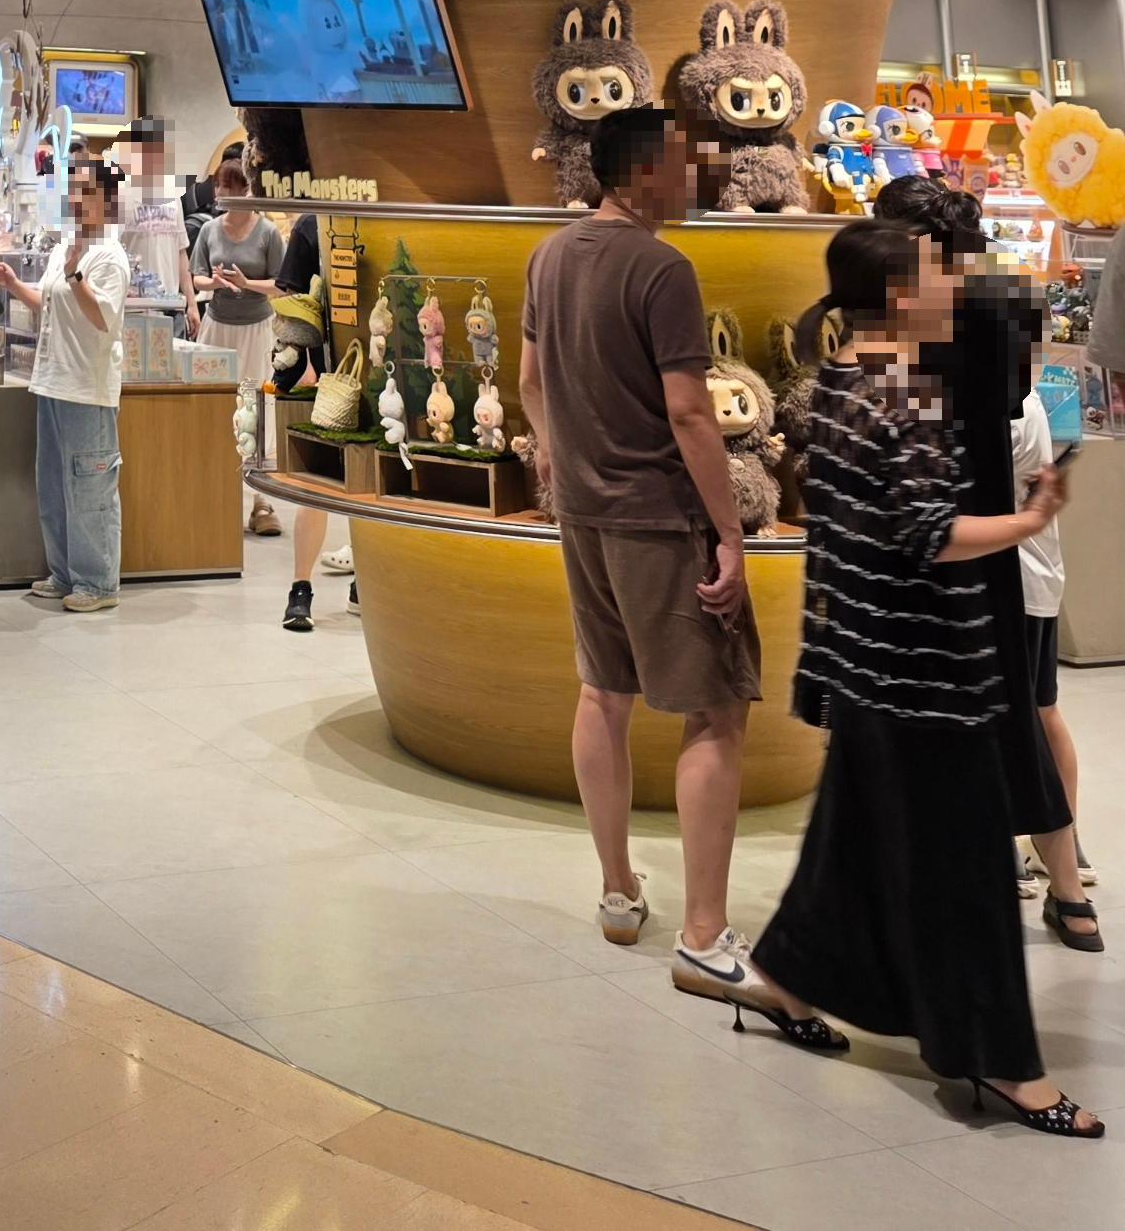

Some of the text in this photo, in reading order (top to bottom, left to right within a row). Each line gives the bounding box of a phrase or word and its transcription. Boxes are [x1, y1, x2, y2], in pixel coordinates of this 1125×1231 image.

[262, 170, 377, 202] The Monsters
[607, 898, 625, 908] NIKE
